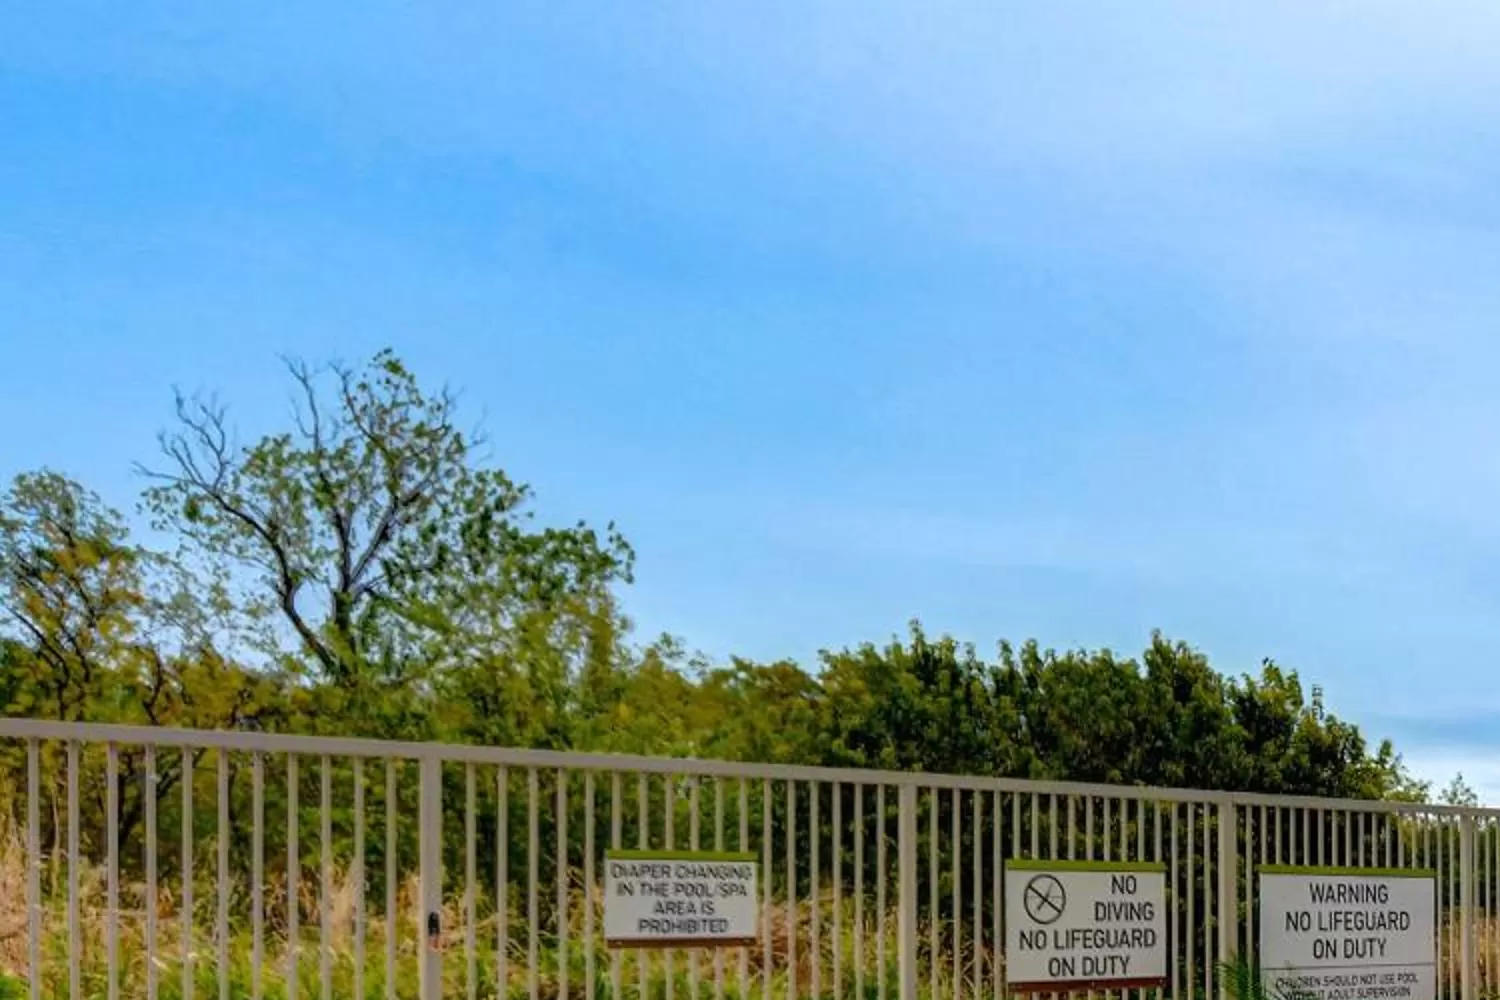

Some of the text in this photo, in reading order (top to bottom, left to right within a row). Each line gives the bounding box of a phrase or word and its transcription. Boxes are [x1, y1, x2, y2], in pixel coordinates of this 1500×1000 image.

[616, 881, 634, 897] IN
[640, 881, 669, 897] THE
[1111, 874, 1137, 895] NO
[1309, 882, 1389, 904] WARNING
[654, 901, 715, 916] AREA IS
[1094, 901, 1155, 922] DIVING
[638, 918, 729, 934] PROHIBITED
[1285, 911, 1410, 931] NO LIFEGUARD
[1019, 928, 1156, 951] NO LIFEGUARD
[1313, 938, 1387, 960] ON DUTY
[1048, 955, 1130, 977] ON DUTY
